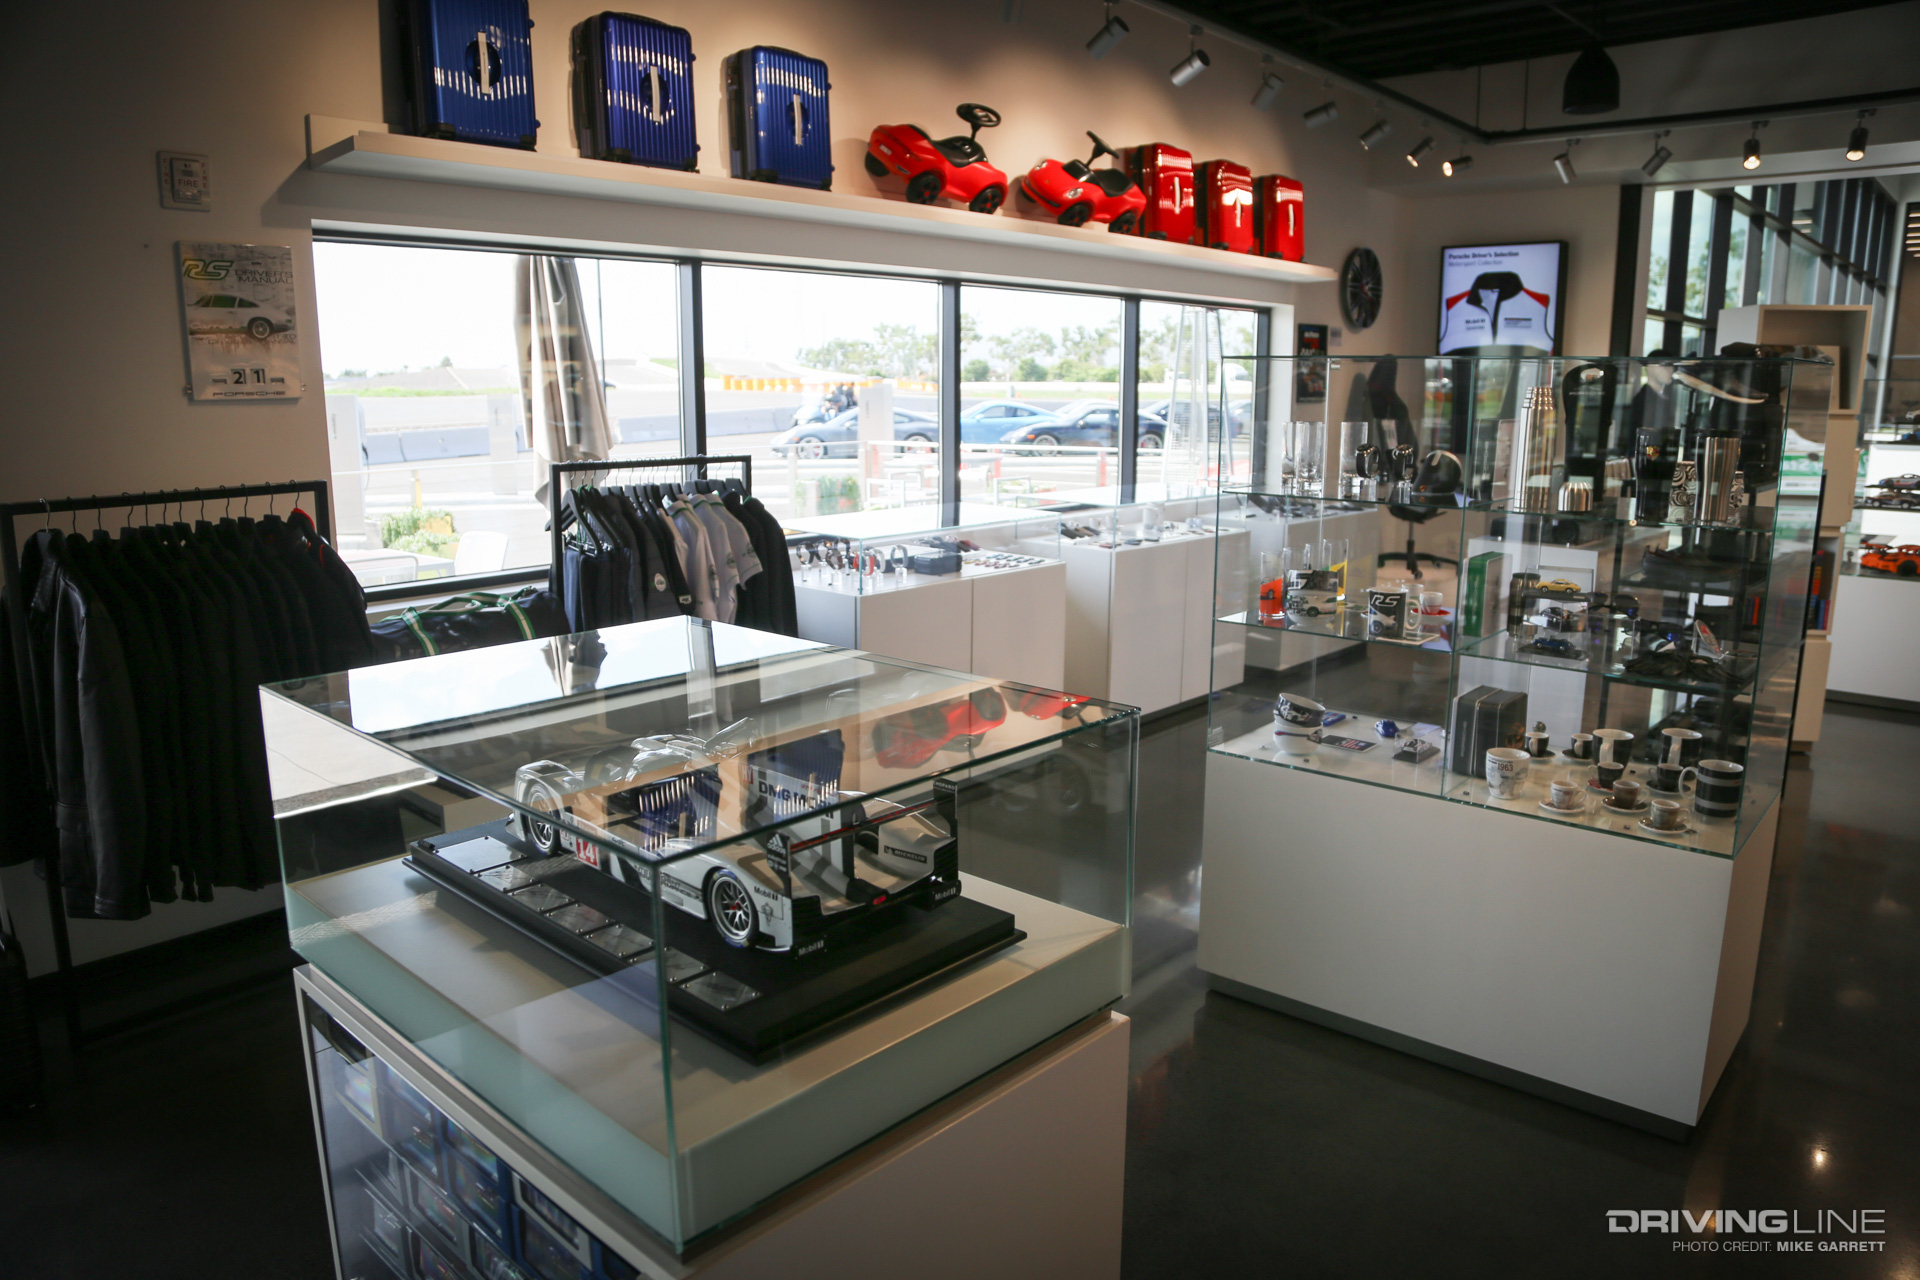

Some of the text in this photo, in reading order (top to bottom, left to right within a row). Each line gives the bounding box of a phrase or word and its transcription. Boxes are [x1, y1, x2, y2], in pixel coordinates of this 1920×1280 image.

[178, 179, 199, 188] FIRE
[183, 258, 234, 281] RS
[235, 269, 293, 278] DRIVER'S
[238, 276, 293, 284] MANUAL
[1371, 595, 1400, 607] RS
[1497, 763, 1514, 772] 1963
[759, 780, 791, 801] DMG
[578, 838, 595, 863] 14
[894, 849, 927, 862] MICHELIN
[754, 886, 771, 900] Mobil
[935, 890, 951, 900] Mobil
[798, 942, 817, 956] Mobil
